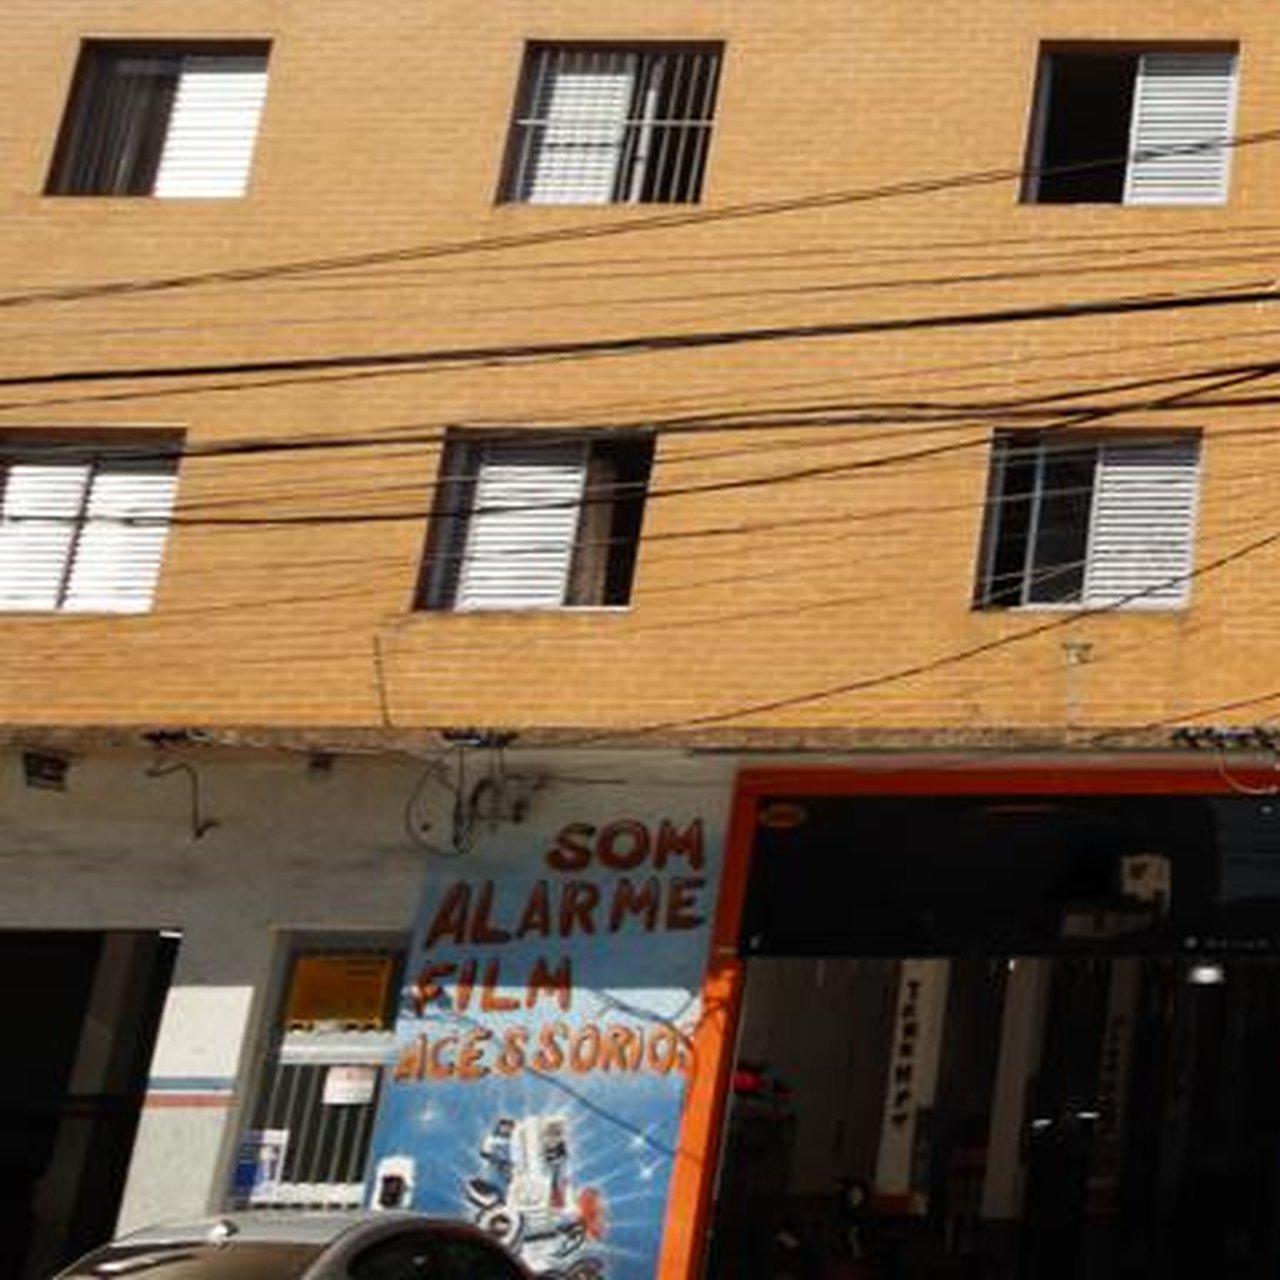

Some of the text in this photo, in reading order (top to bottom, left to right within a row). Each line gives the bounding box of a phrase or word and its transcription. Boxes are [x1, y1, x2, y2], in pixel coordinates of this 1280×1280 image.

[546, 817, 705, 872] SOM
[424, 877, 706, 950] ALARME
[414, 957, 572, 1017] FILM
